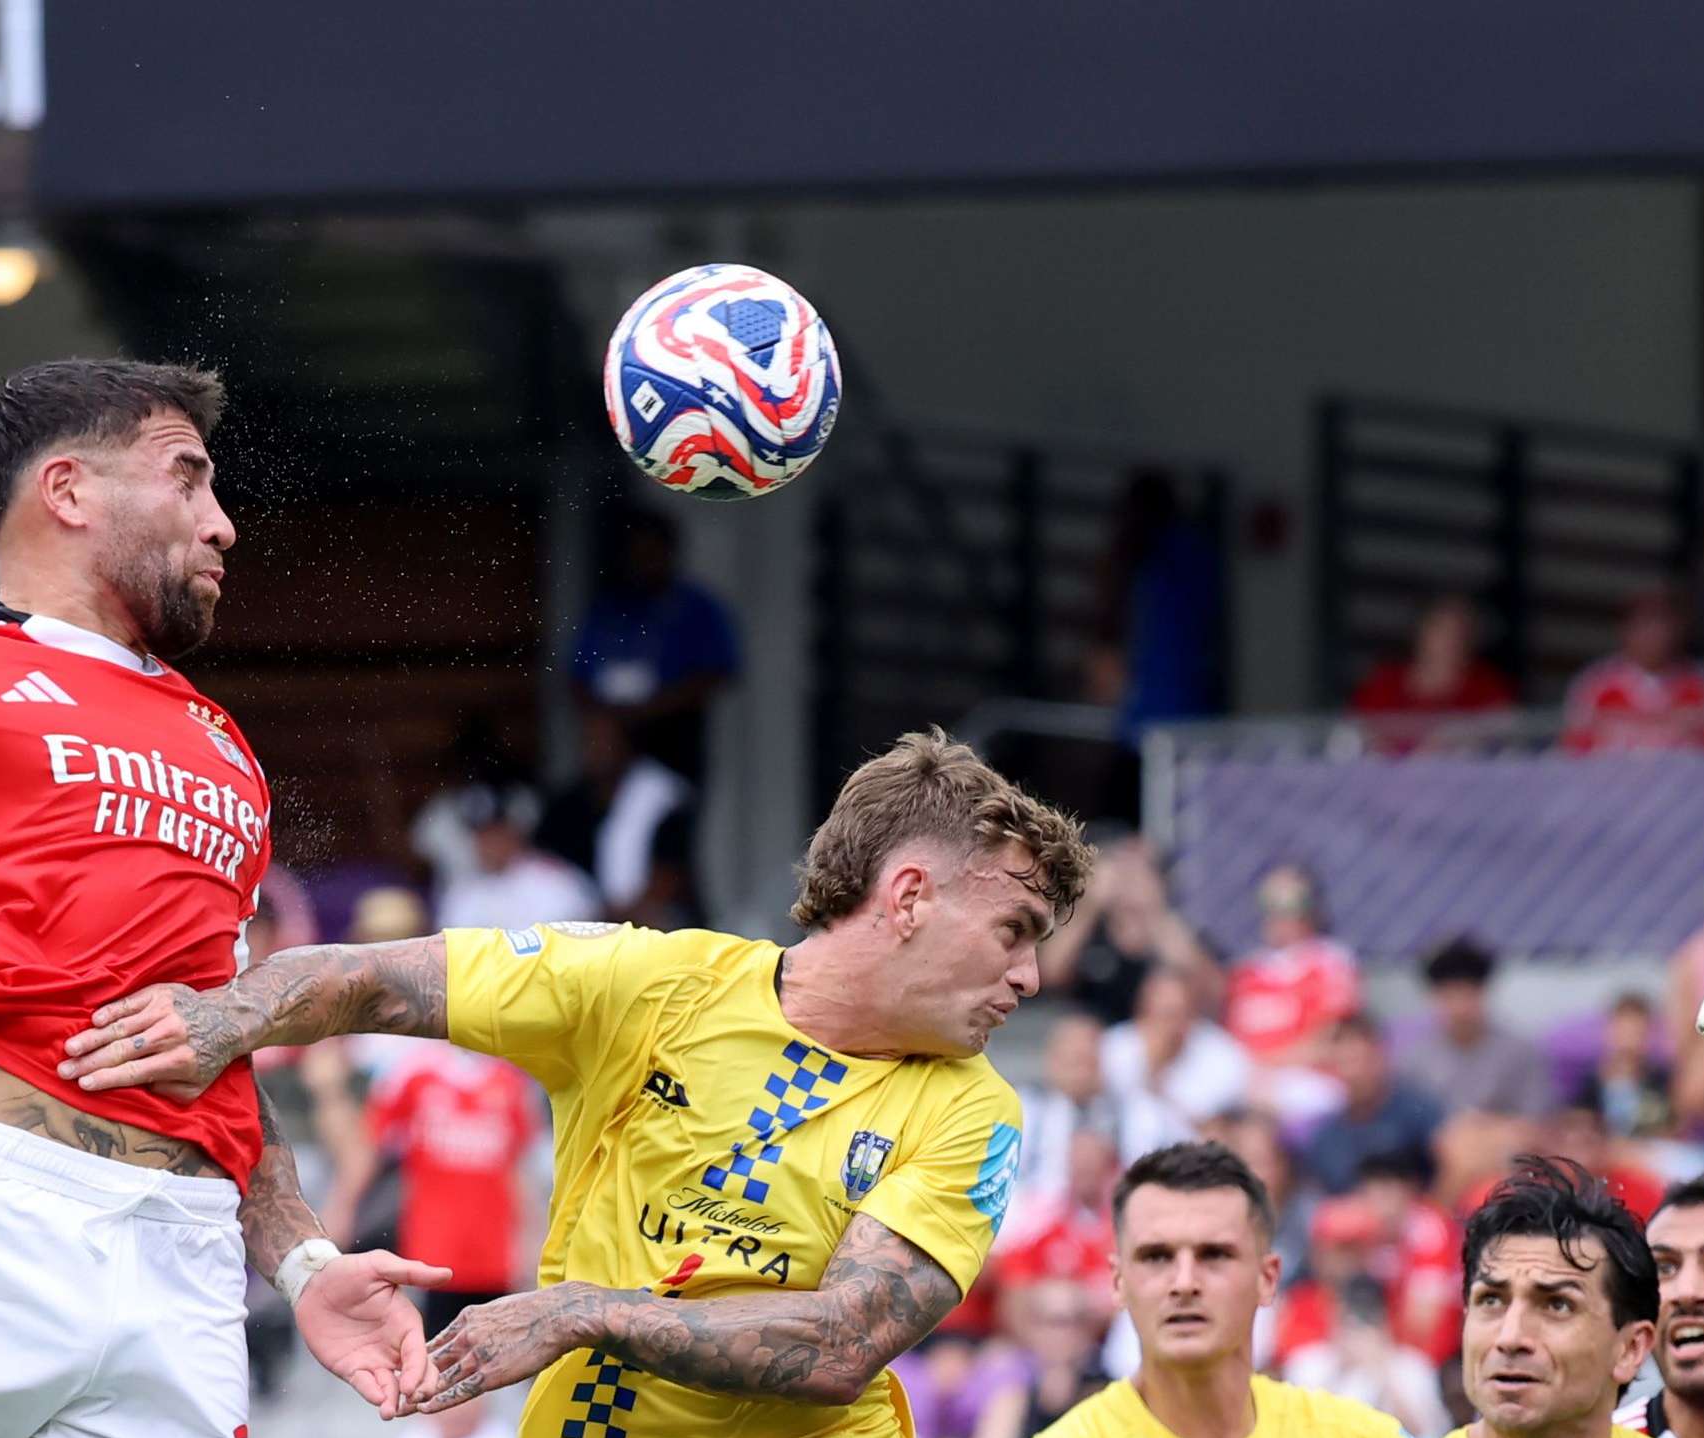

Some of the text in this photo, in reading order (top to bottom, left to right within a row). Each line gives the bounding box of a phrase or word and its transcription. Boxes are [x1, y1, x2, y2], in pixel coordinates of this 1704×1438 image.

[42, 733, 264, 855] Emirates
[94, 791, 246, 883] FLY BETTER
[666, 1186, 789, 1235] Michelob
